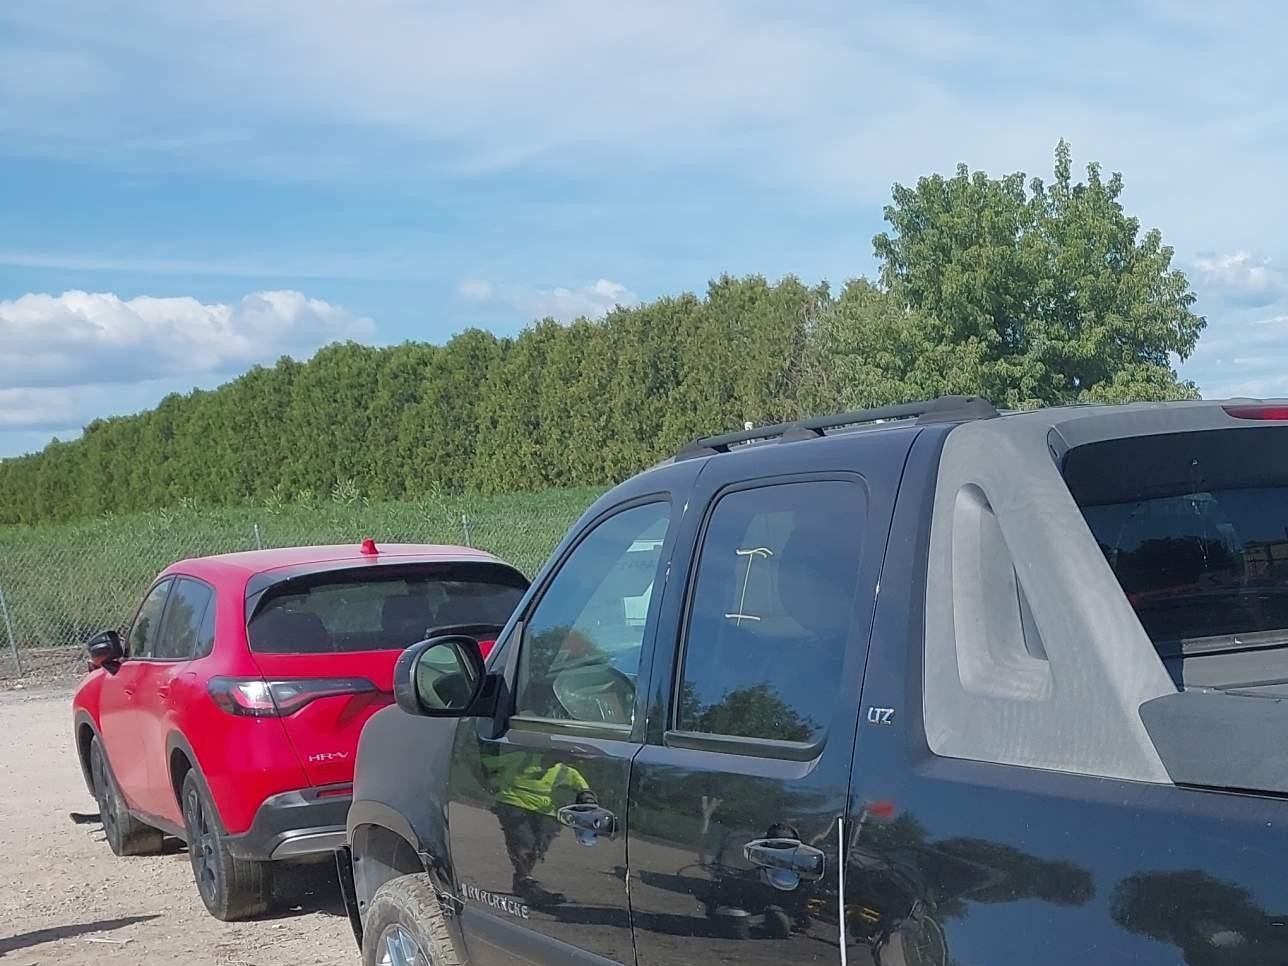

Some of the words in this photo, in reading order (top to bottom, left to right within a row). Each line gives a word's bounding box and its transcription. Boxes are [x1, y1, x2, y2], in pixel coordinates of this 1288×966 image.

[867, 706, 895, 725] LTZ
[308, 751, 349, 762] HR-V
[468, 885, 529, 920] AVALANCHE
